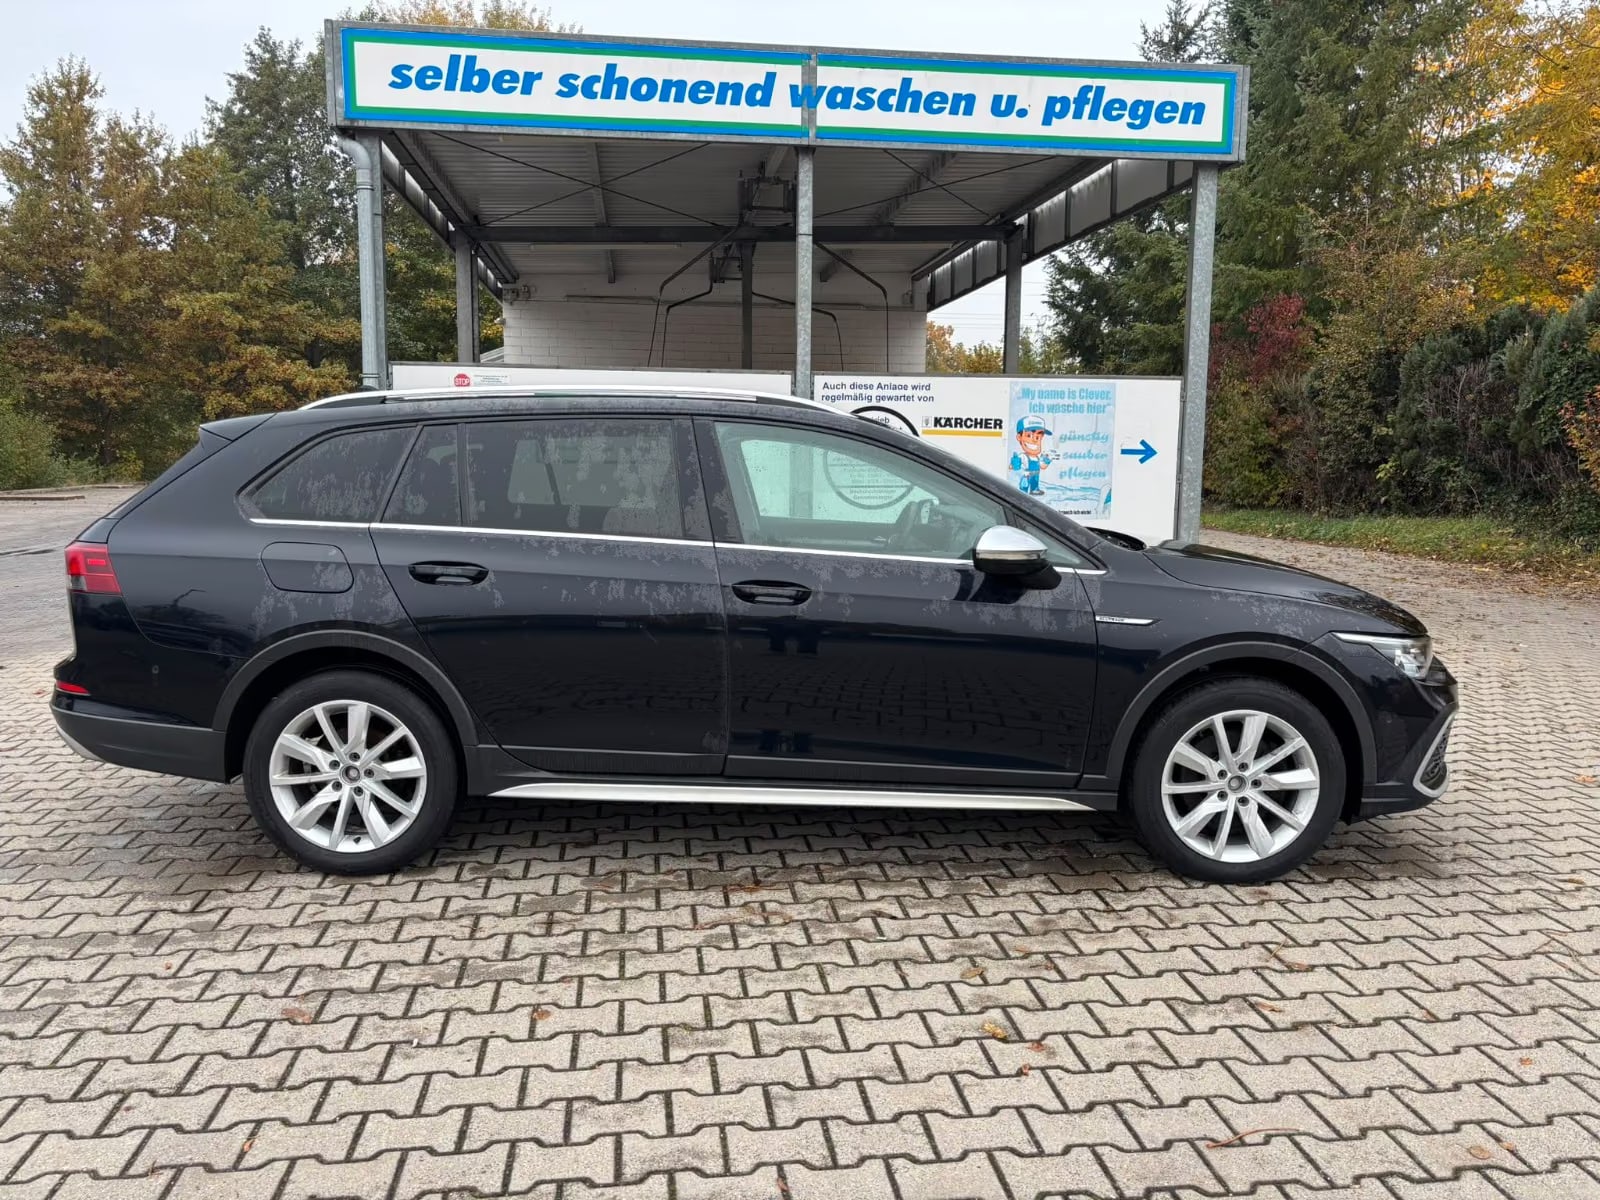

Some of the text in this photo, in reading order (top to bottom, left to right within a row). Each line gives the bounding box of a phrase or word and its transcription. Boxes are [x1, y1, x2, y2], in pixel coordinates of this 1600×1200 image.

[388, 54, 1206, 130] selber schonend waschen u. pflegen
[455, 378, 470, 386] STOP
[822, 382, 931, 392] Auch diese Anlage wird
[821, 393, 873, 403] regelmäßig
[875, 394, 915, 403] gewartet
[1038, 389, 1065, 400] name
[1068, 388, 1077, 399] is
[1029, 402, 1045, 413] Ich
[933, 416, 1003, 430] KÄRCHER
